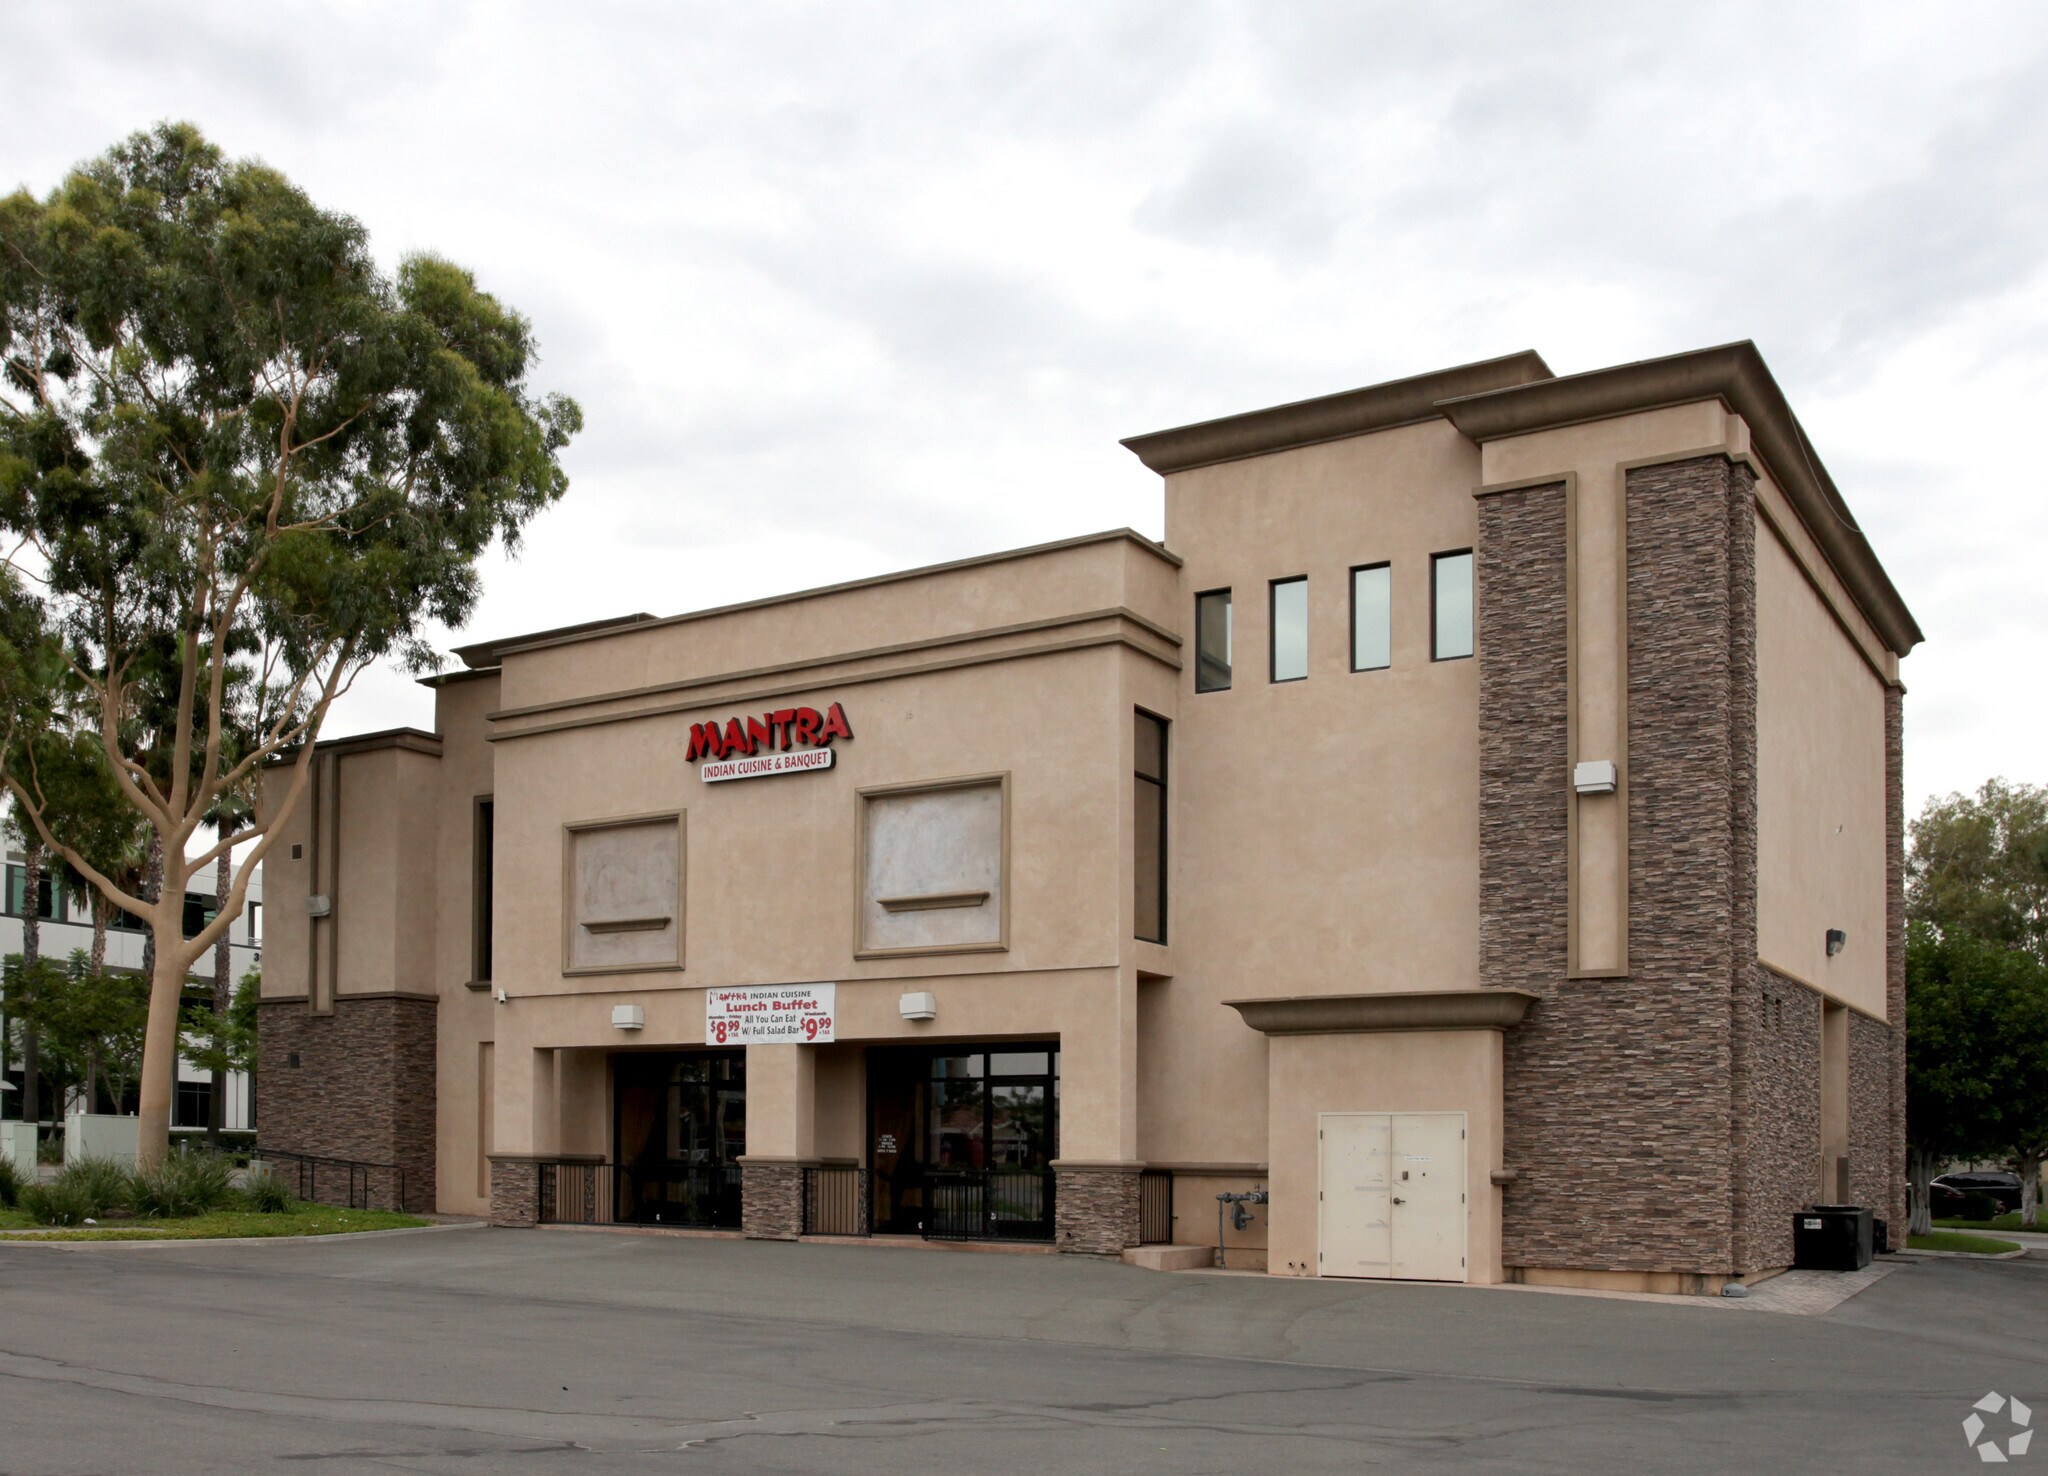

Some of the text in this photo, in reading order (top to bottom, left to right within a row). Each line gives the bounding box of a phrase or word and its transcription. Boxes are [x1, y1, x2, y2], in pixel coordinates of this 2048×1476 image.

[685, 702, 854, 762] MANTRA
[704, 751, 828, 779] INDIAN CUISINE & BANQUET
[750, 992, 778, 1000] INDIAN
[781, 991, 811, 999] CUISINE
[726, 1000, 818, 1012] Lunch Buffet
[745, 1012, 796, 1024] All You Can Eat
[752, 1026, 766, 1035] Full
[767, 1025, 786, 1035] Salad
[787, 1025, 800, 1034] Bar
